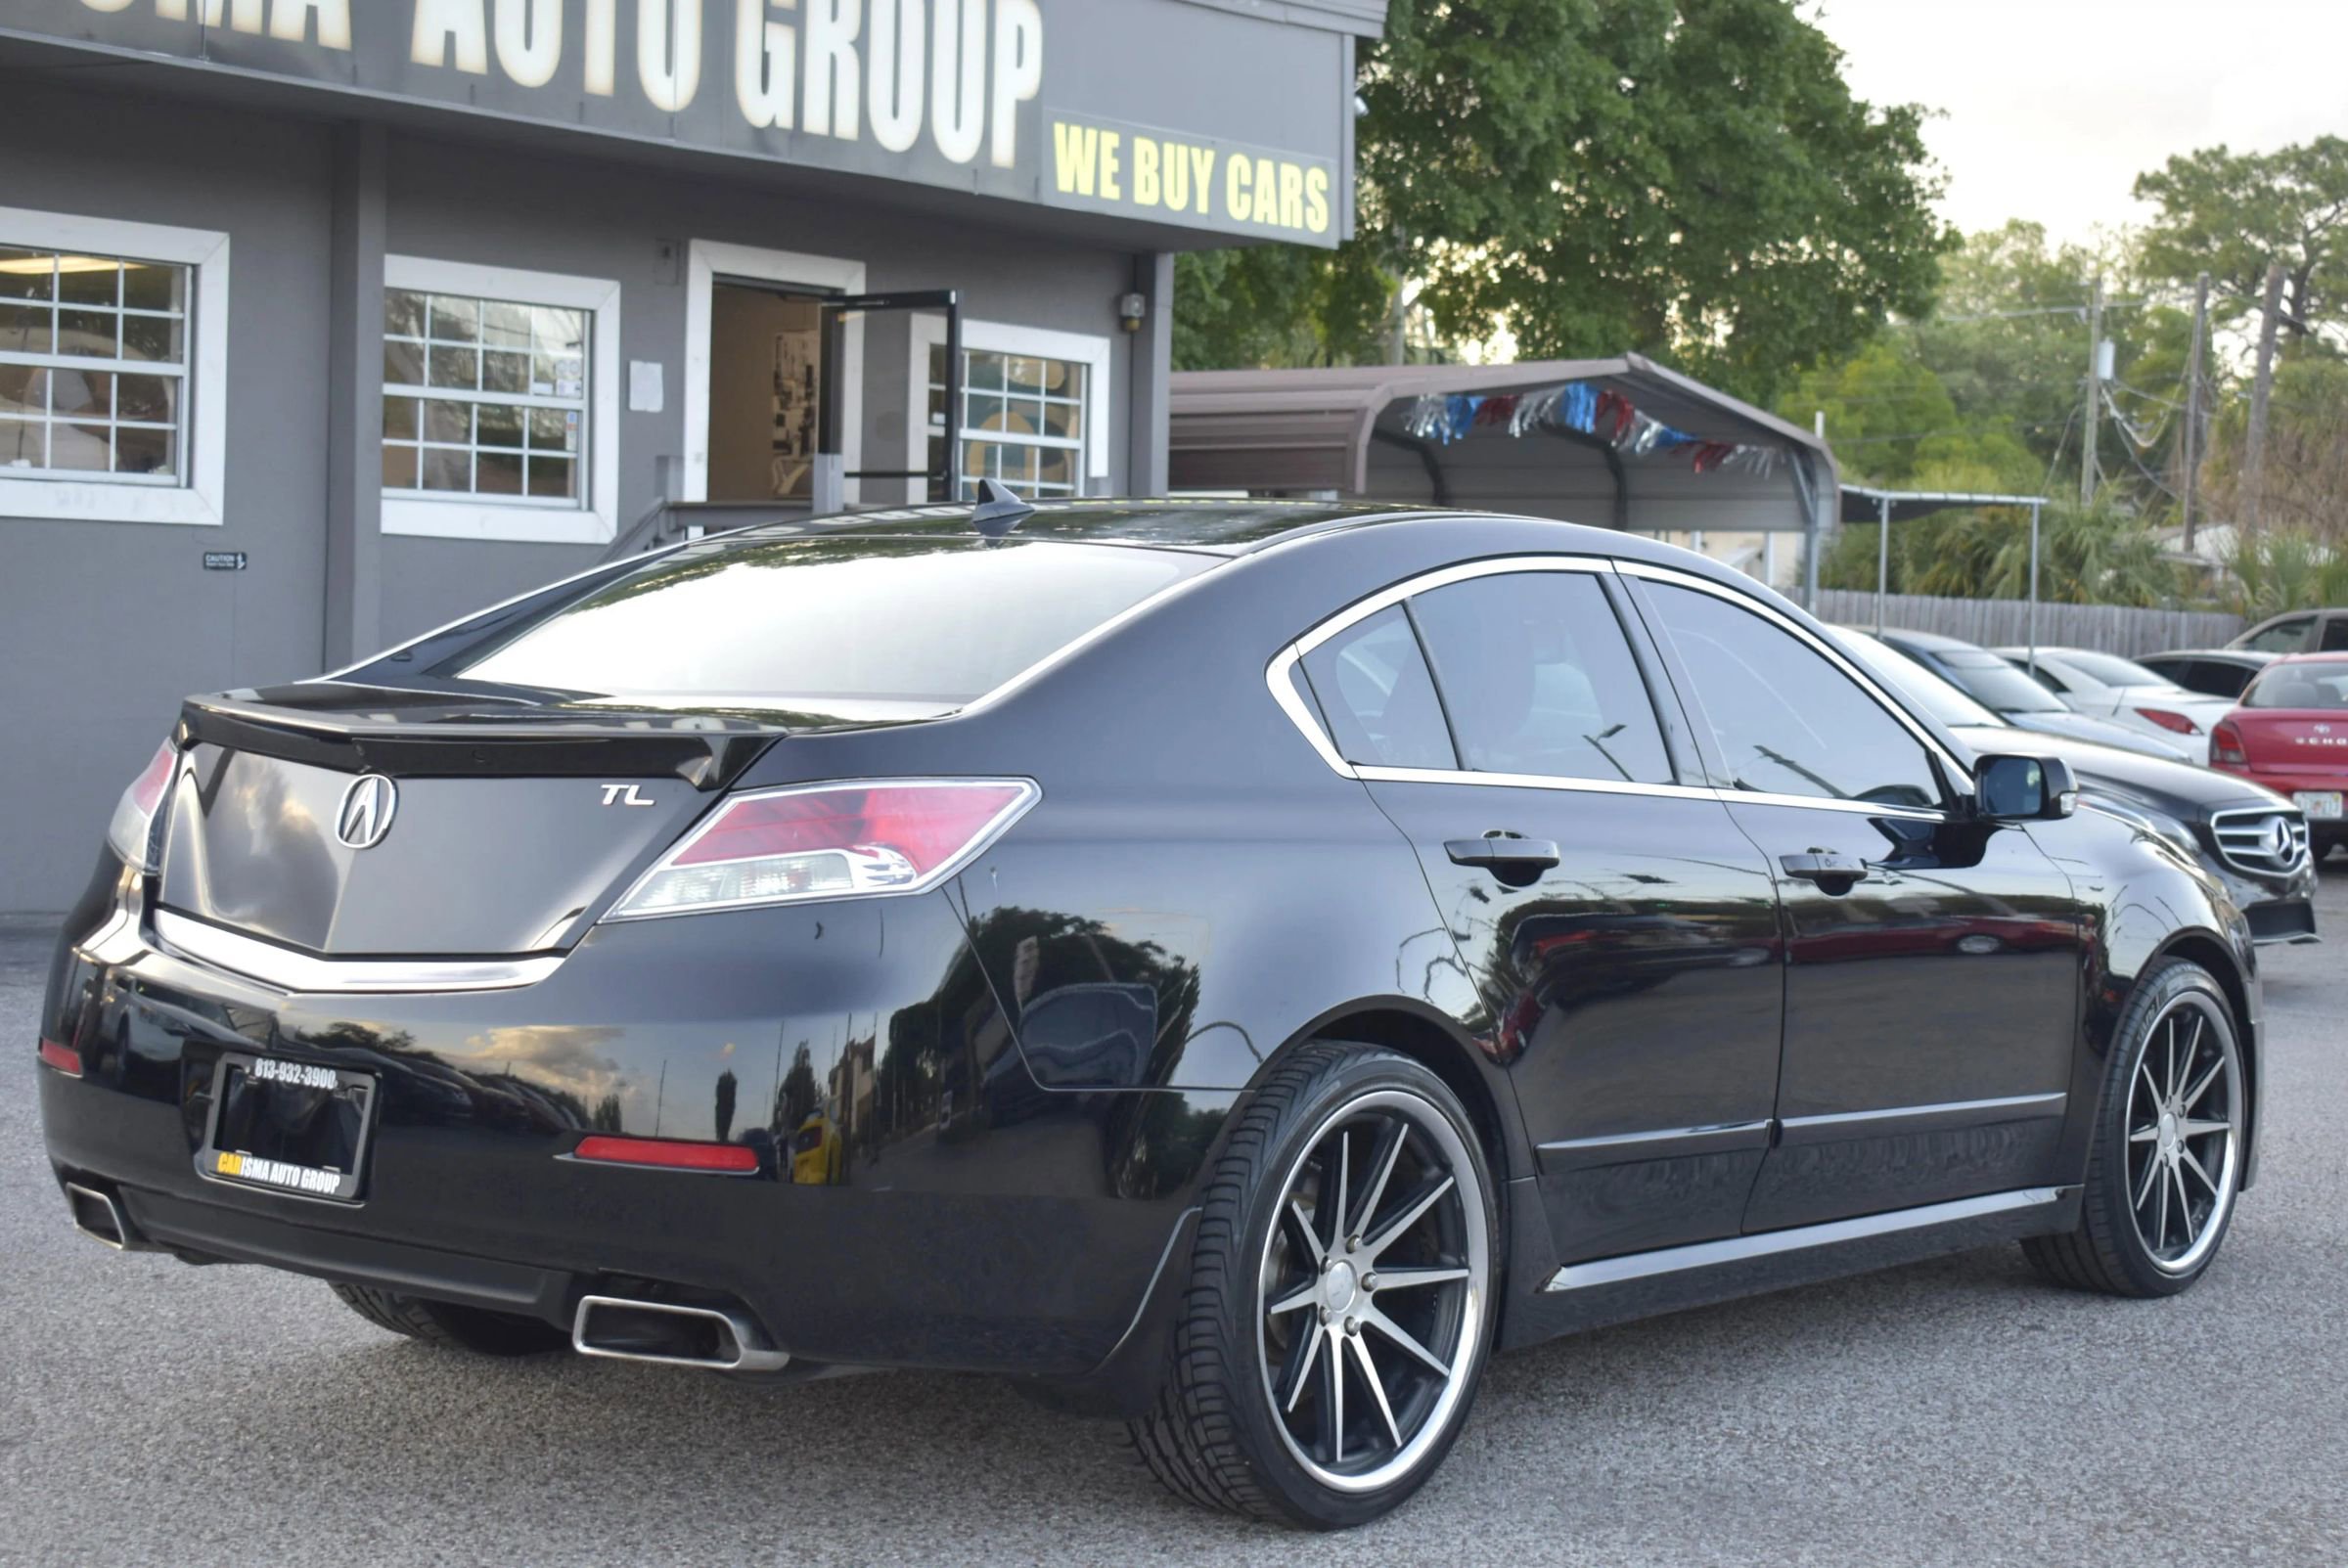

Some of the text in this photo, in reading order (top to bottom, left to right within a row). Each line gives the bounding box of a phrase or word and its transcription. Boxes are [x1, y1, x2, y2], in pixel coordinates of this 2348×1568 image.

[735, 0, 1043, 170] GROUP
[1054, 121, 1329, 233] WE BUY CARS
[601, 784, 655, 806] TL
[254, 1057, 337, 1090] 813-932-3900
[217, 1151, 341, 1194] CARISMA AUTO GROUP
